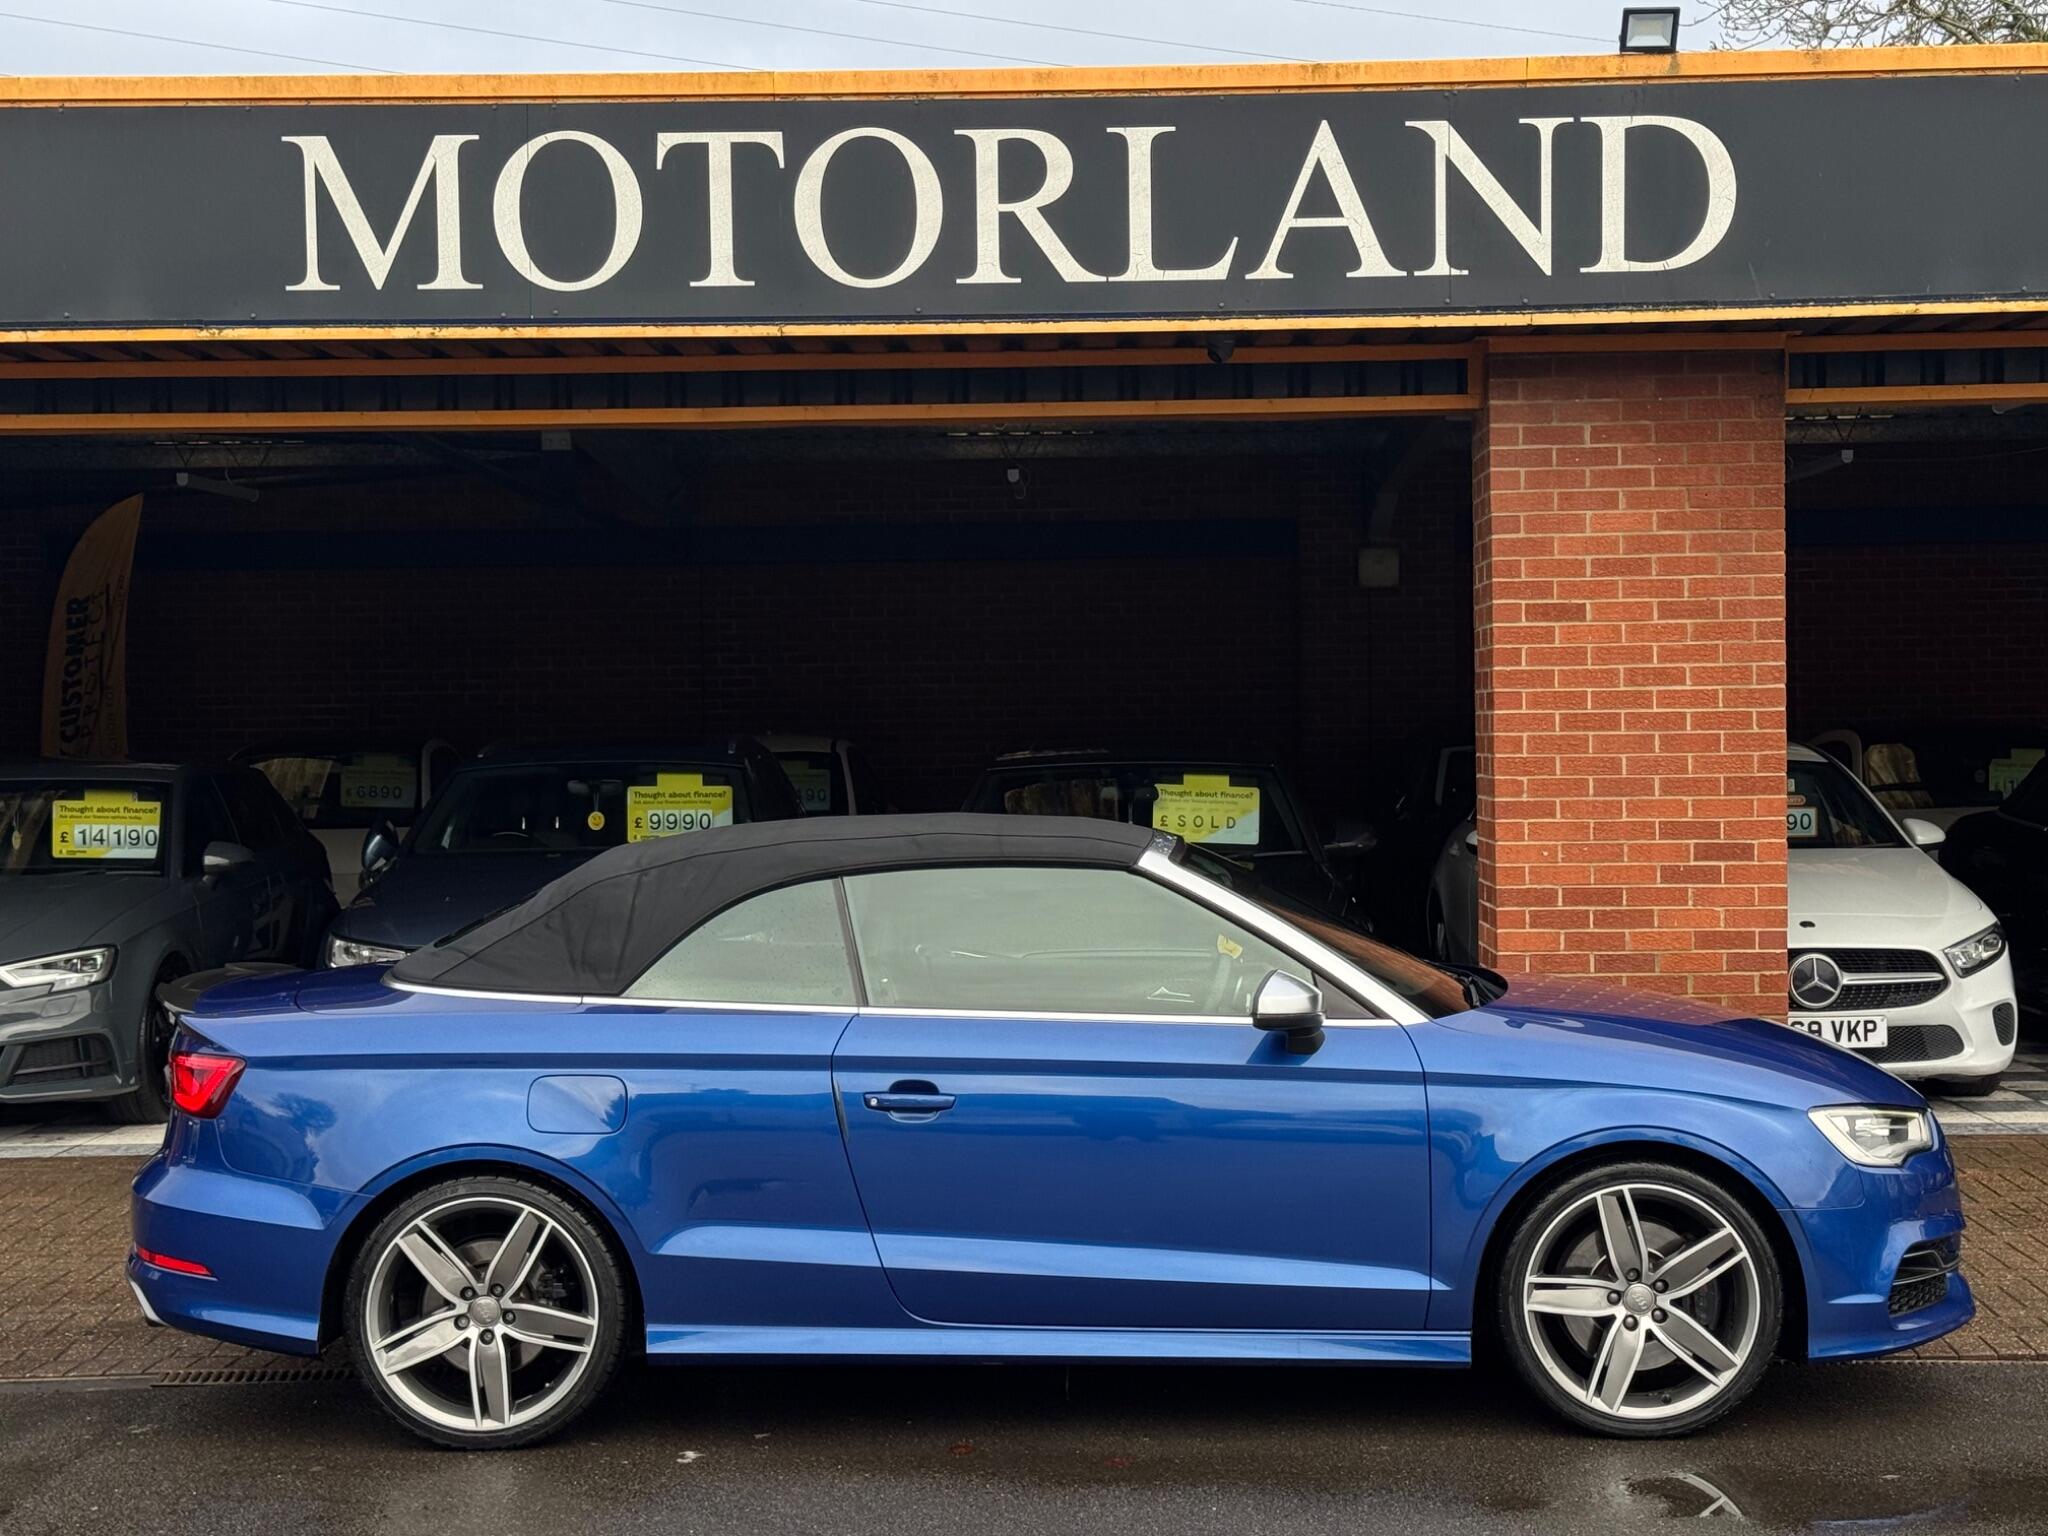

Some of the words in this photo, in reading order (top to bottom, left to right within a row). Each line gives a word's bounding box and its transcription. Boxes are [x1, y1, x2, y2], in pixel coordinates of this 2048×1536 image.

[281, 115, 1737, 292] MOTORLAND
[60, 597, 90, 743] CUSTOMER
[356, 785, 402, 799] 6890
[634, 791, 666, 800] Thought
[668, 791, 691, 799] about
[693, 790, 727, 799] finance?
[1160, 788, 1193, 798] Thought
[1195, 789, 1218, 798] about
[1220, 790, 1254, 800] finance?
[59, 805, 94, 815] Thought
[96, 805, 120, 814] about
[123, 805, 158, 815] finance?
[649, 812, 712, 831] 9990
[77, 828, 158, 847] 14190
[1831, 1019, 1877, 1042] VKP
